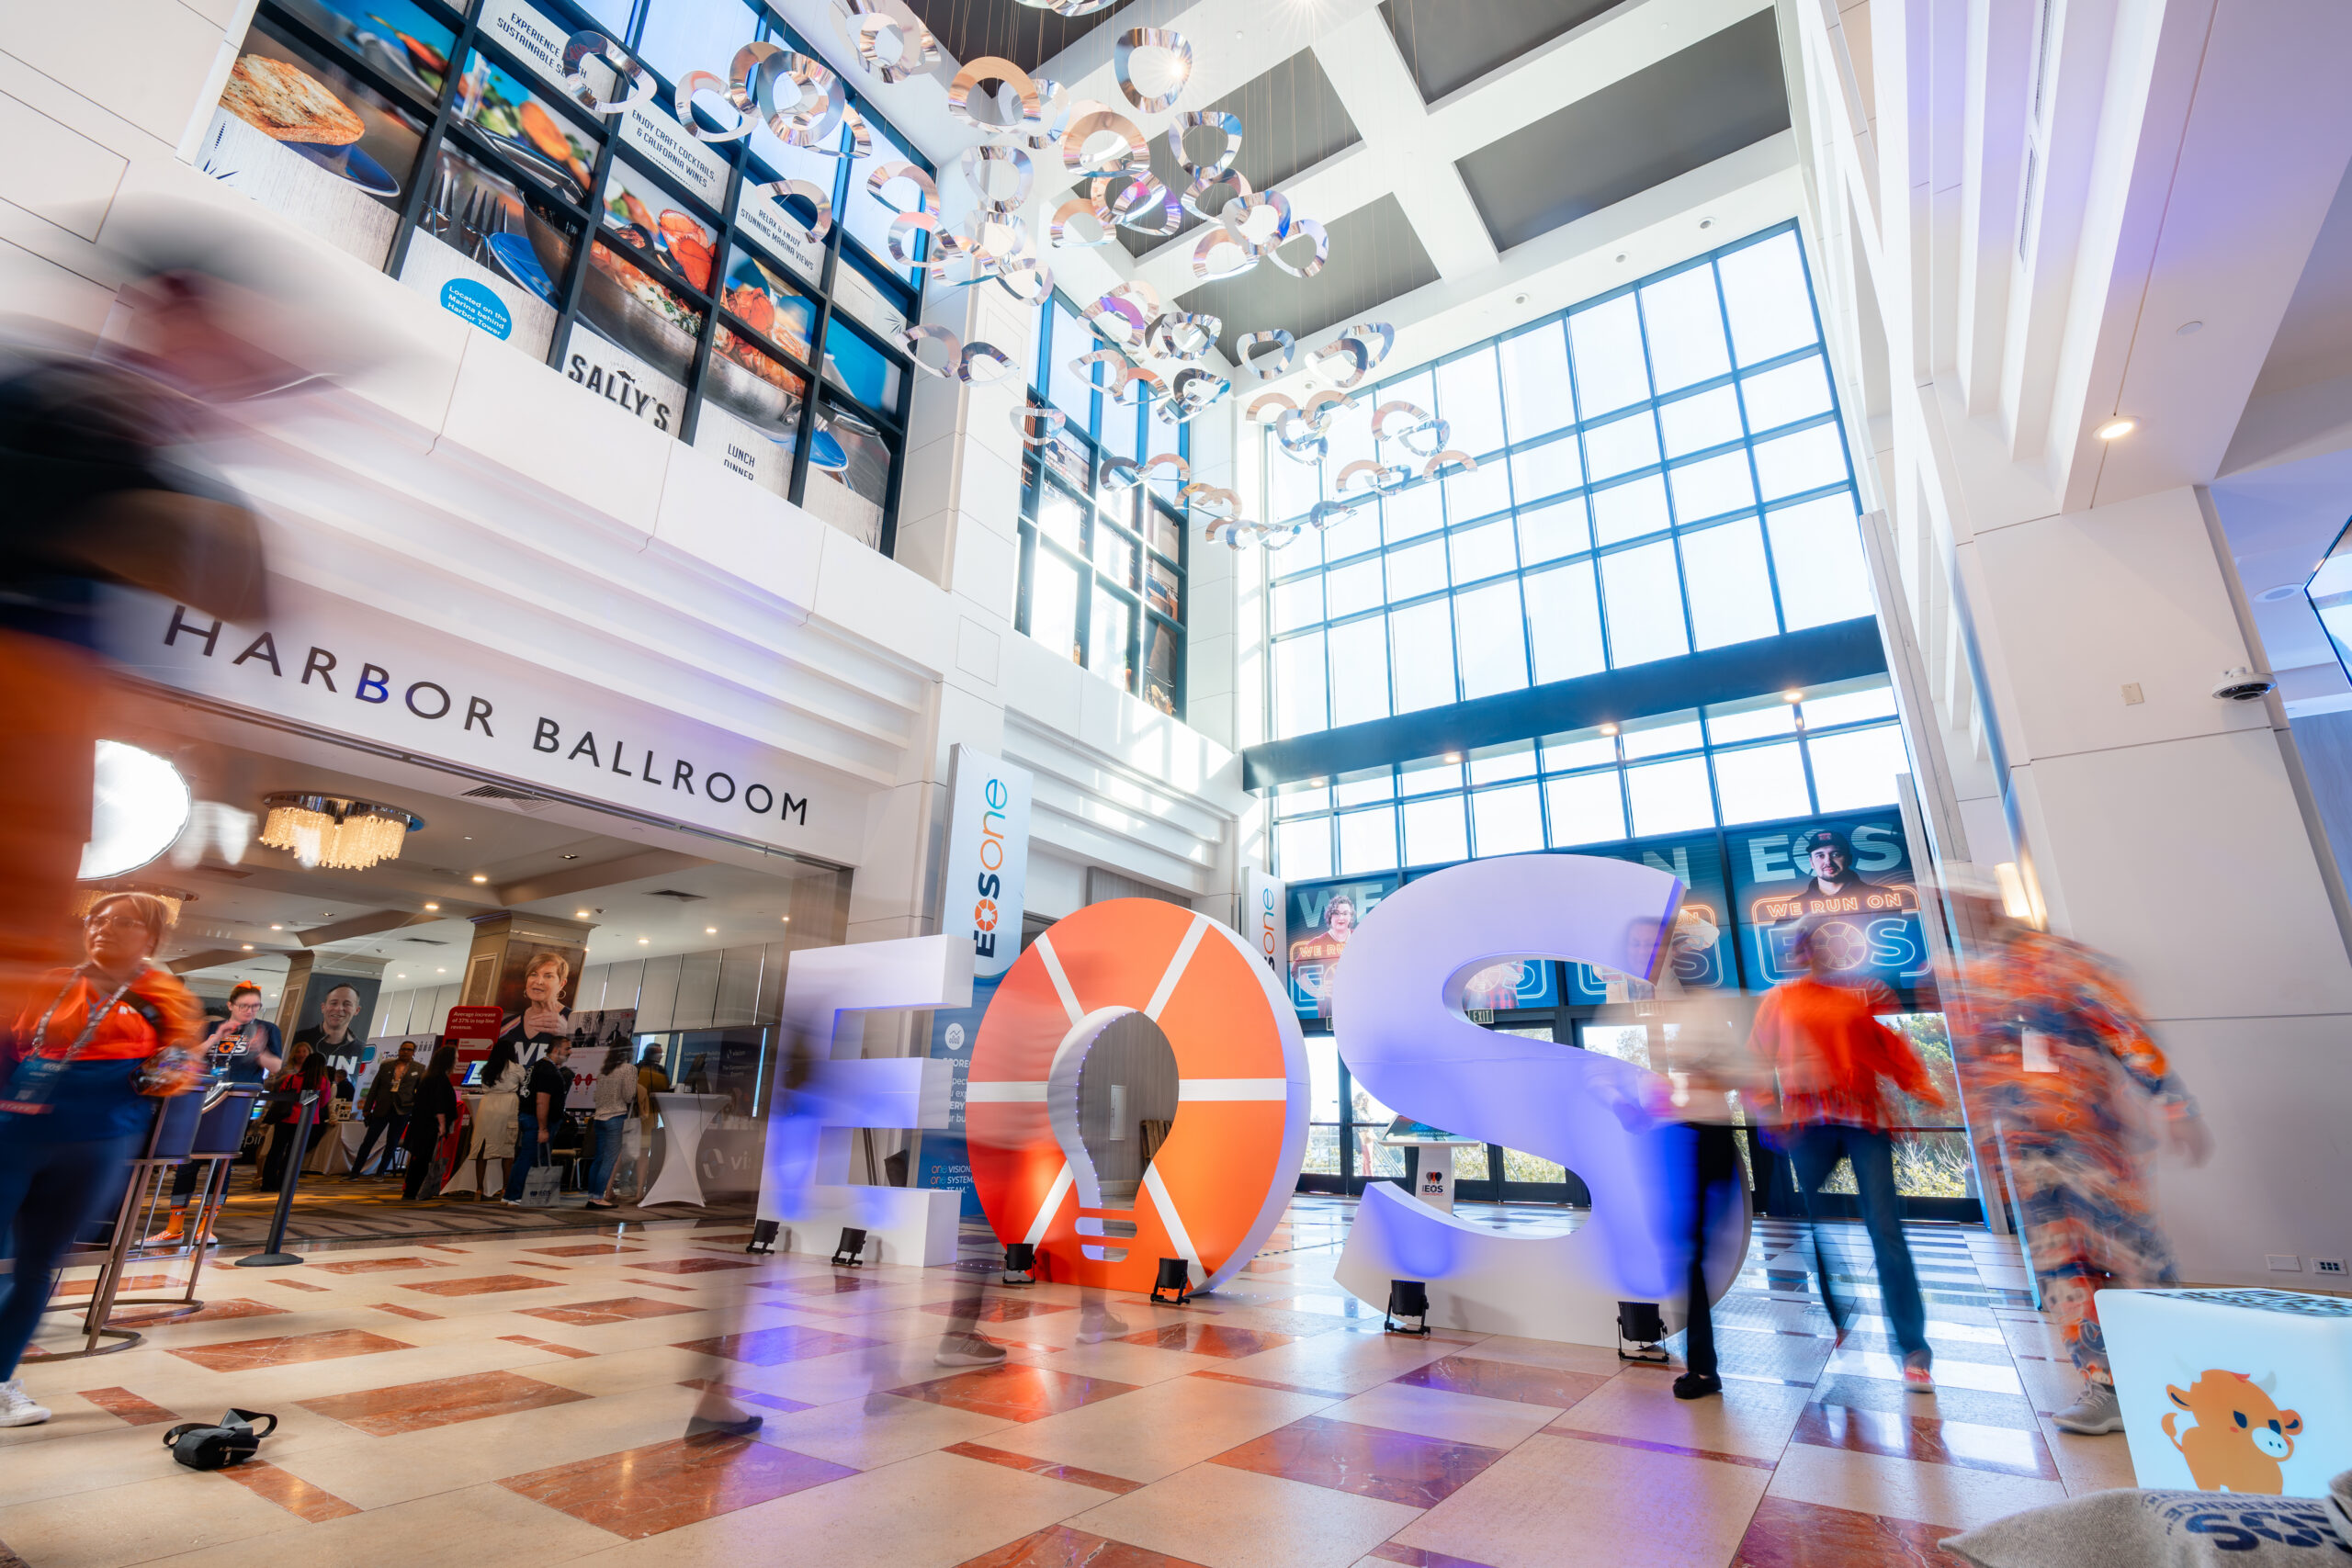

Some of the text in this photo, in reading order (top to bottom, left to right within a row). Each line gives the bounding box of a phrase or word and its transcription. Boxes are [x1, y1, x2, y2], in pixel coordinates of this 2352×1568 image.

[496, 17, 555, 69] SUSTAINABLE
[511, 12, 561, 58] EXPERIENCE
[632, 109, 716, 182] ENJOY CRAFT COCKTAILS,
[637, 127, 707, 188] & CALIFORNIA WINES
[741, 209, 814, 271] STUNNING MARINA VIEWS
[758, 209, 776, 230] RELAX
[783, 230, 801, 248] ENJOY
[447, 302, 502, 335] Harbor Tower
[448, 286, 507, 323] Located on the
[448, 294, 504, 330] Marina behind
[568, 354, 672, 432] SALLY'S
[728, 443, 755, 468] LUNCH
[164, 604, 808, 827] HARBOR BALLROOM
[1767, 893, 1903, 918] WE RUN ON
[1299, 943, 1347, 958] WE RU
[1473, 1010, 1490, 1022] EXIT
[1424, 1184, 1443, 1193] EOS
